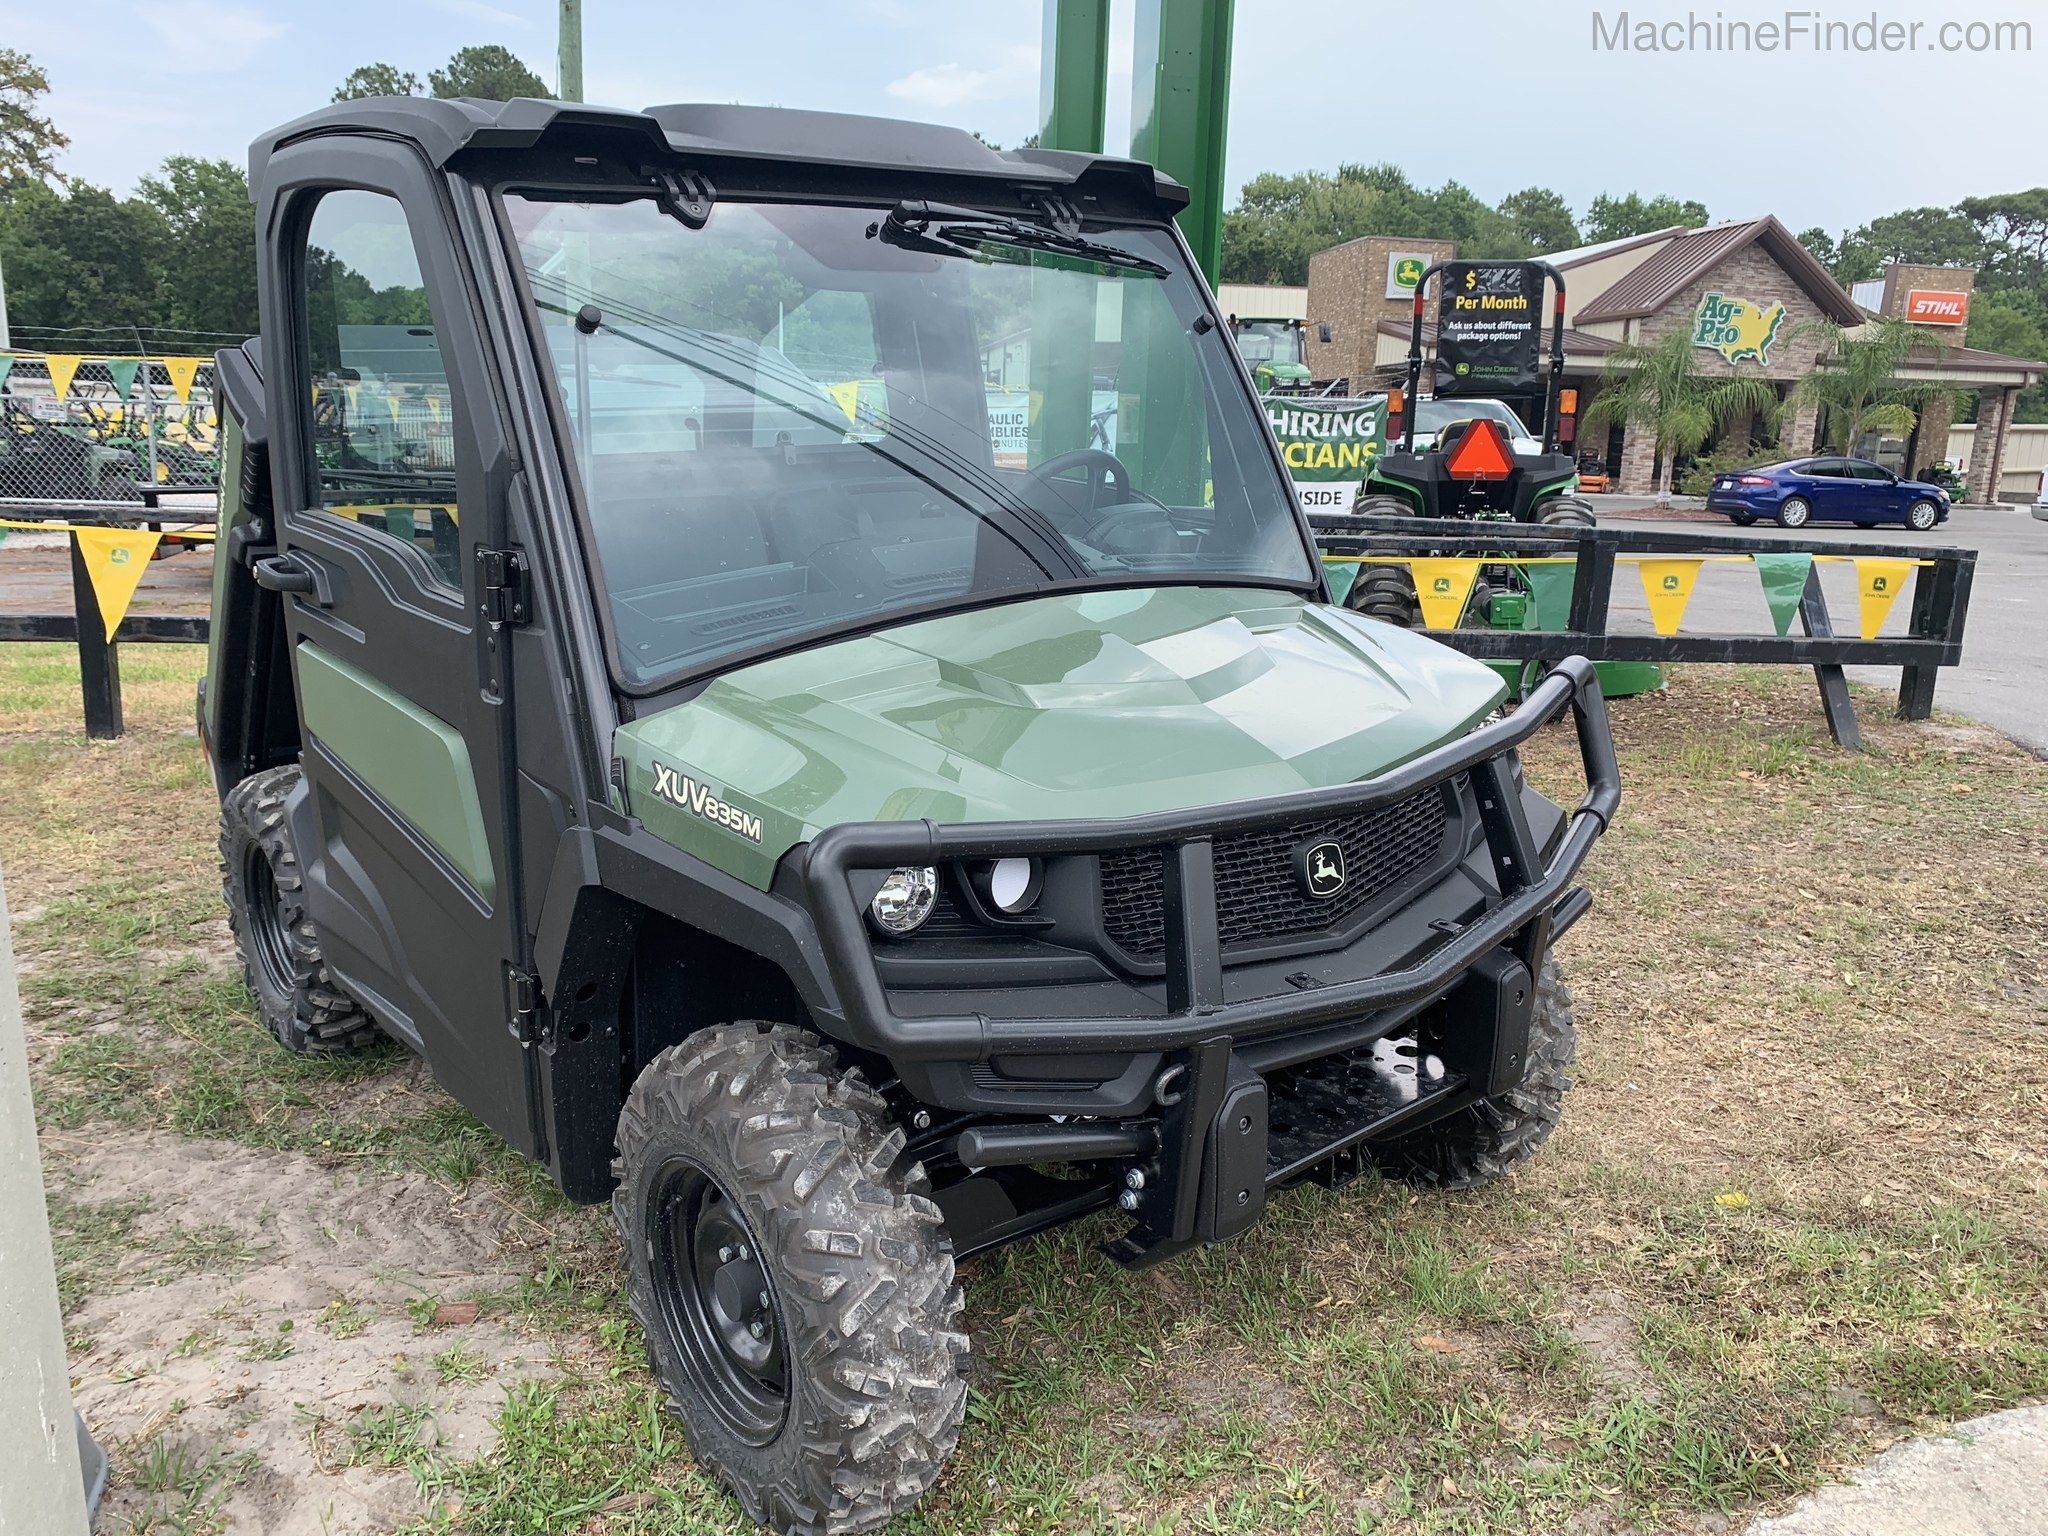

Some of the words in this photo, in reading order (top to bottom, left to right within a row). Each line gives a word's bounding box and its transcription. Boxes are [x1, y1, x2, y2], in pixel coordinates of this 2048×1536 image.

[1465, 270, 1476, 290] $
[1455, 295, 1479, 310] Per
[1481, 294, 1528, 310] Month
[1699, 294, 1743, 325] Ag-
[1913, 299, 1962, 316] STIHL
[1448, 321, 1462, 331] Ask
[1463, 323, 1473, 331] us
[1474, 321, 1496, 331] about
[1497, 321, 1532, 331] different
[1696, 319, 1739, 344] Pro
[1457, 332, 1488, 342] package
[1489, 331, 1522, 342] options!
[1471, 365, 1493, 374] JOHN
[1493, 365, 1520, 374] DEERE
[1268, 409, 1376, 437] HIRING
[1299, 490, 1343, 506] SIDE
